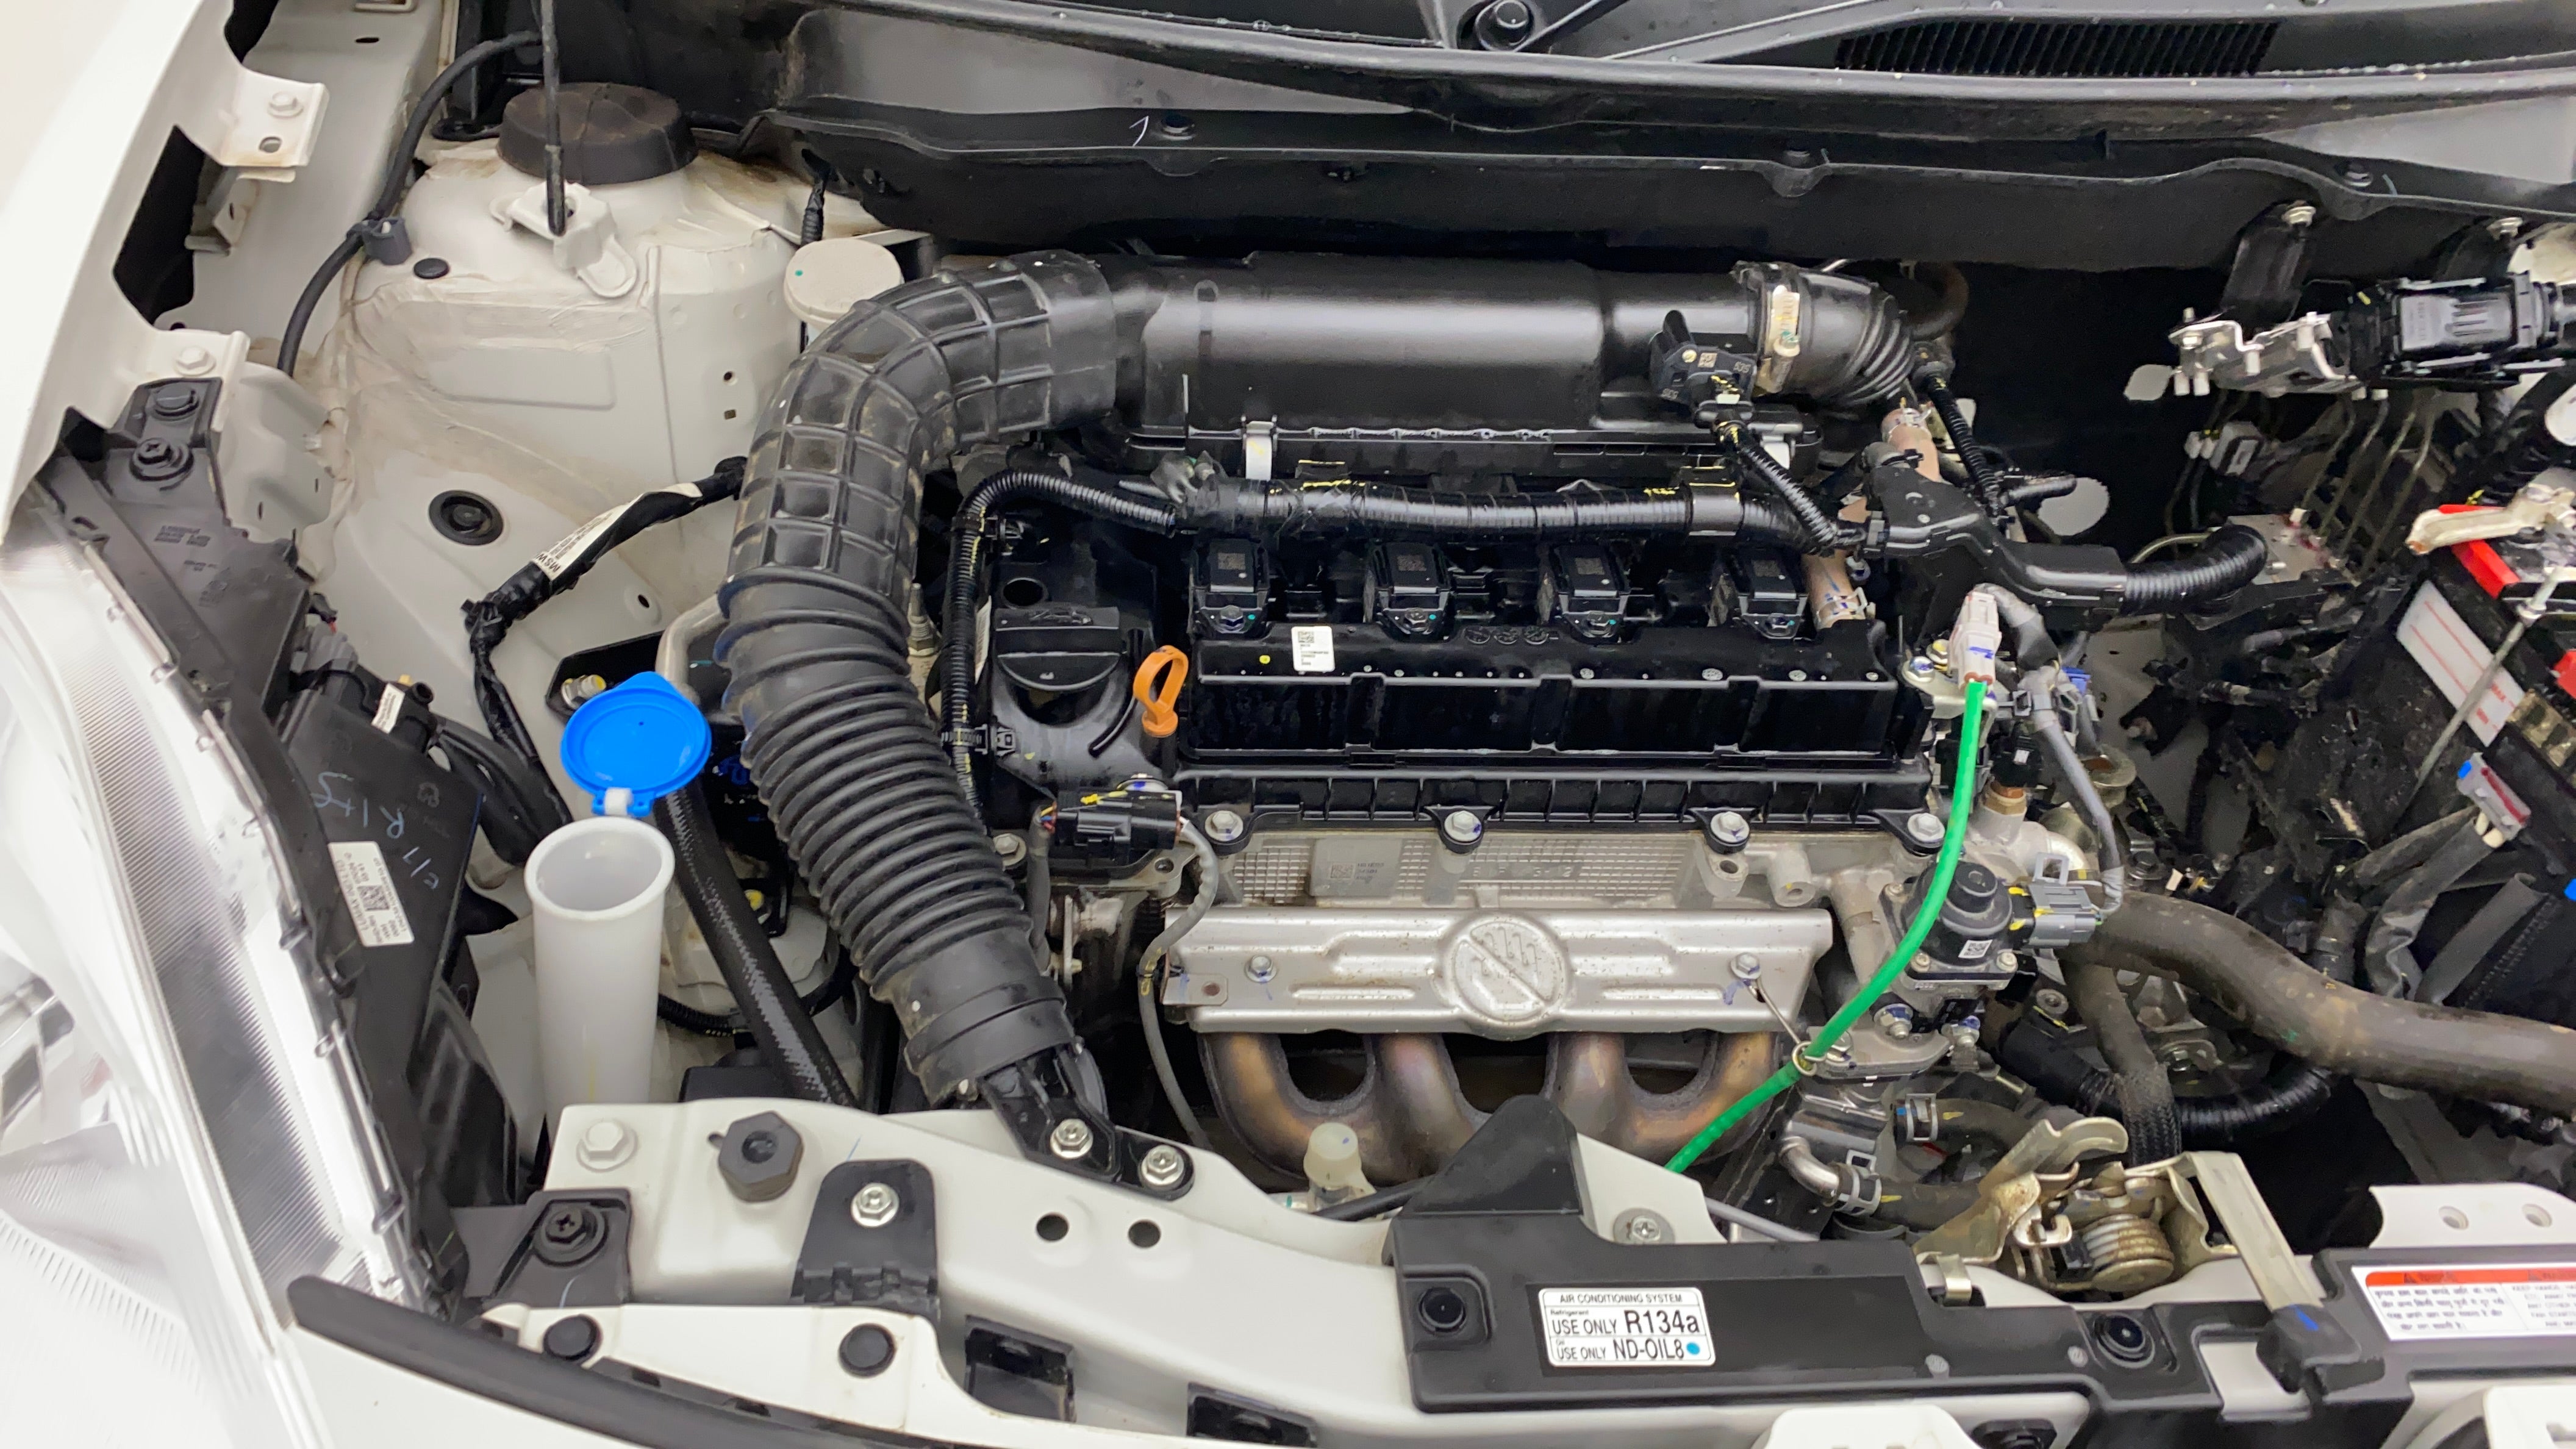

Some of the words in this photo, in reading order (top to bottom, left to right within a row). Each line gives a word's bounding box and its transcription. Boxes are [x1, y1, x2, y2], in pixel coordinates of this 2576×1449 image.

[1559, 1294, 1575, 1303] AIR
[1577, 1293, 1644, 1303] CONDITIONING
[1645, 1293, 1683, 1303] SYSTEM
[1552, 1320, 1580, 1335] USE
[1583, 1319, 1617, 1334] ONLY
[1623, 1309, 1700, 1334] R134a
[1556, 1347, 1578, 1361] USE
[1580, 1347, 1606, 1360] ONLY
[1612, 1338, 1685, 1360] ND-OIL8
